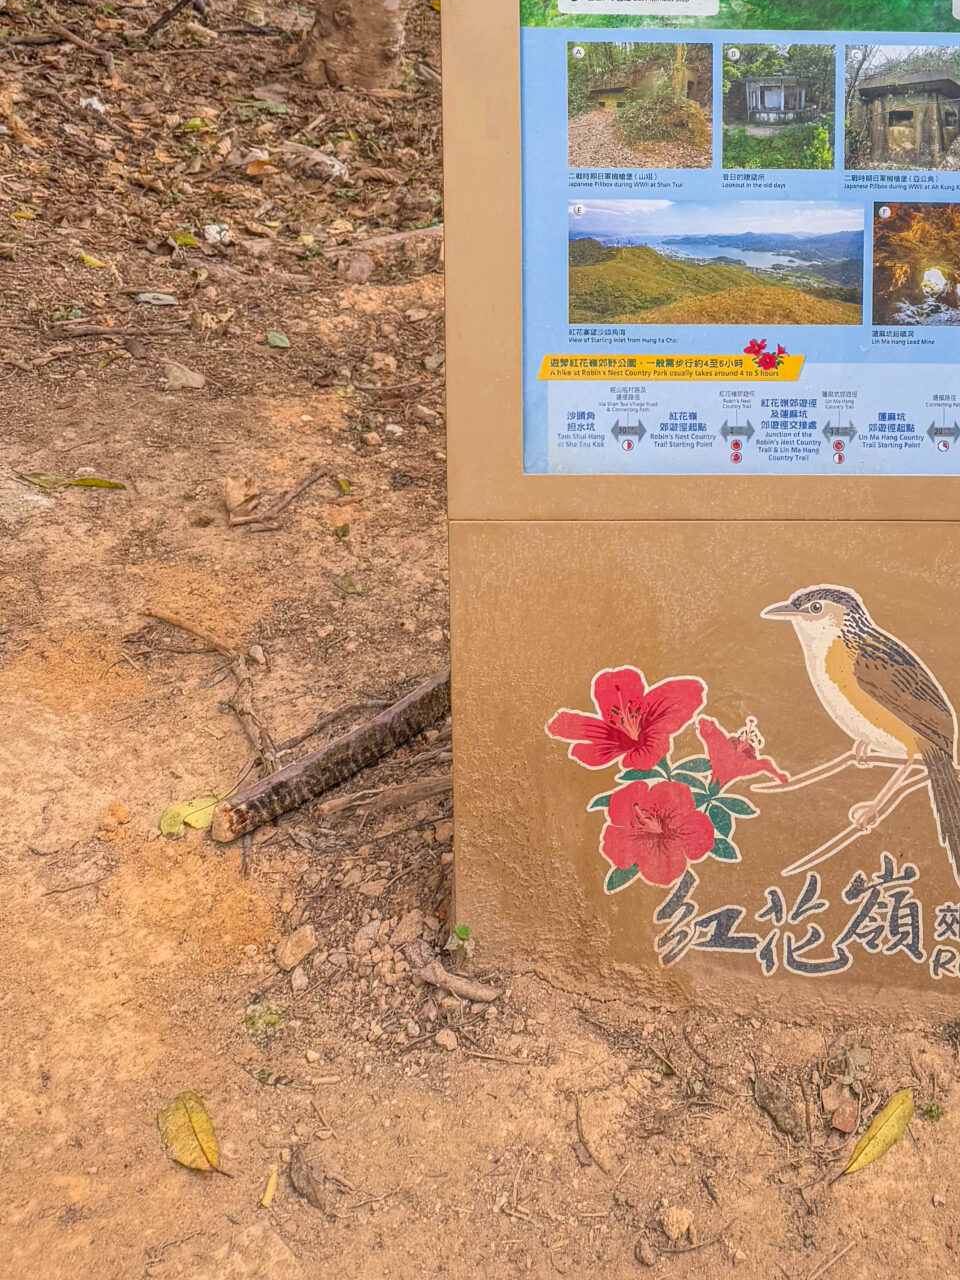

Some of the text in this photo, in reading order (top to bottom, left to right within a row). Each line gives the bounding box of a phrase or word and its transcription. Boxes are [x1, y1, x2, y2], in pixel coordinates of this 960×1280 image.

[624, 370, 651, 378] Country
[669, 370, 693, 378] usually
[692, 434, 716, 442] Country
[669, 441, 694, 449] Starting
[878, 442, 903, 450] Starting
[654, 854, 927, 976] 紅花嶺
